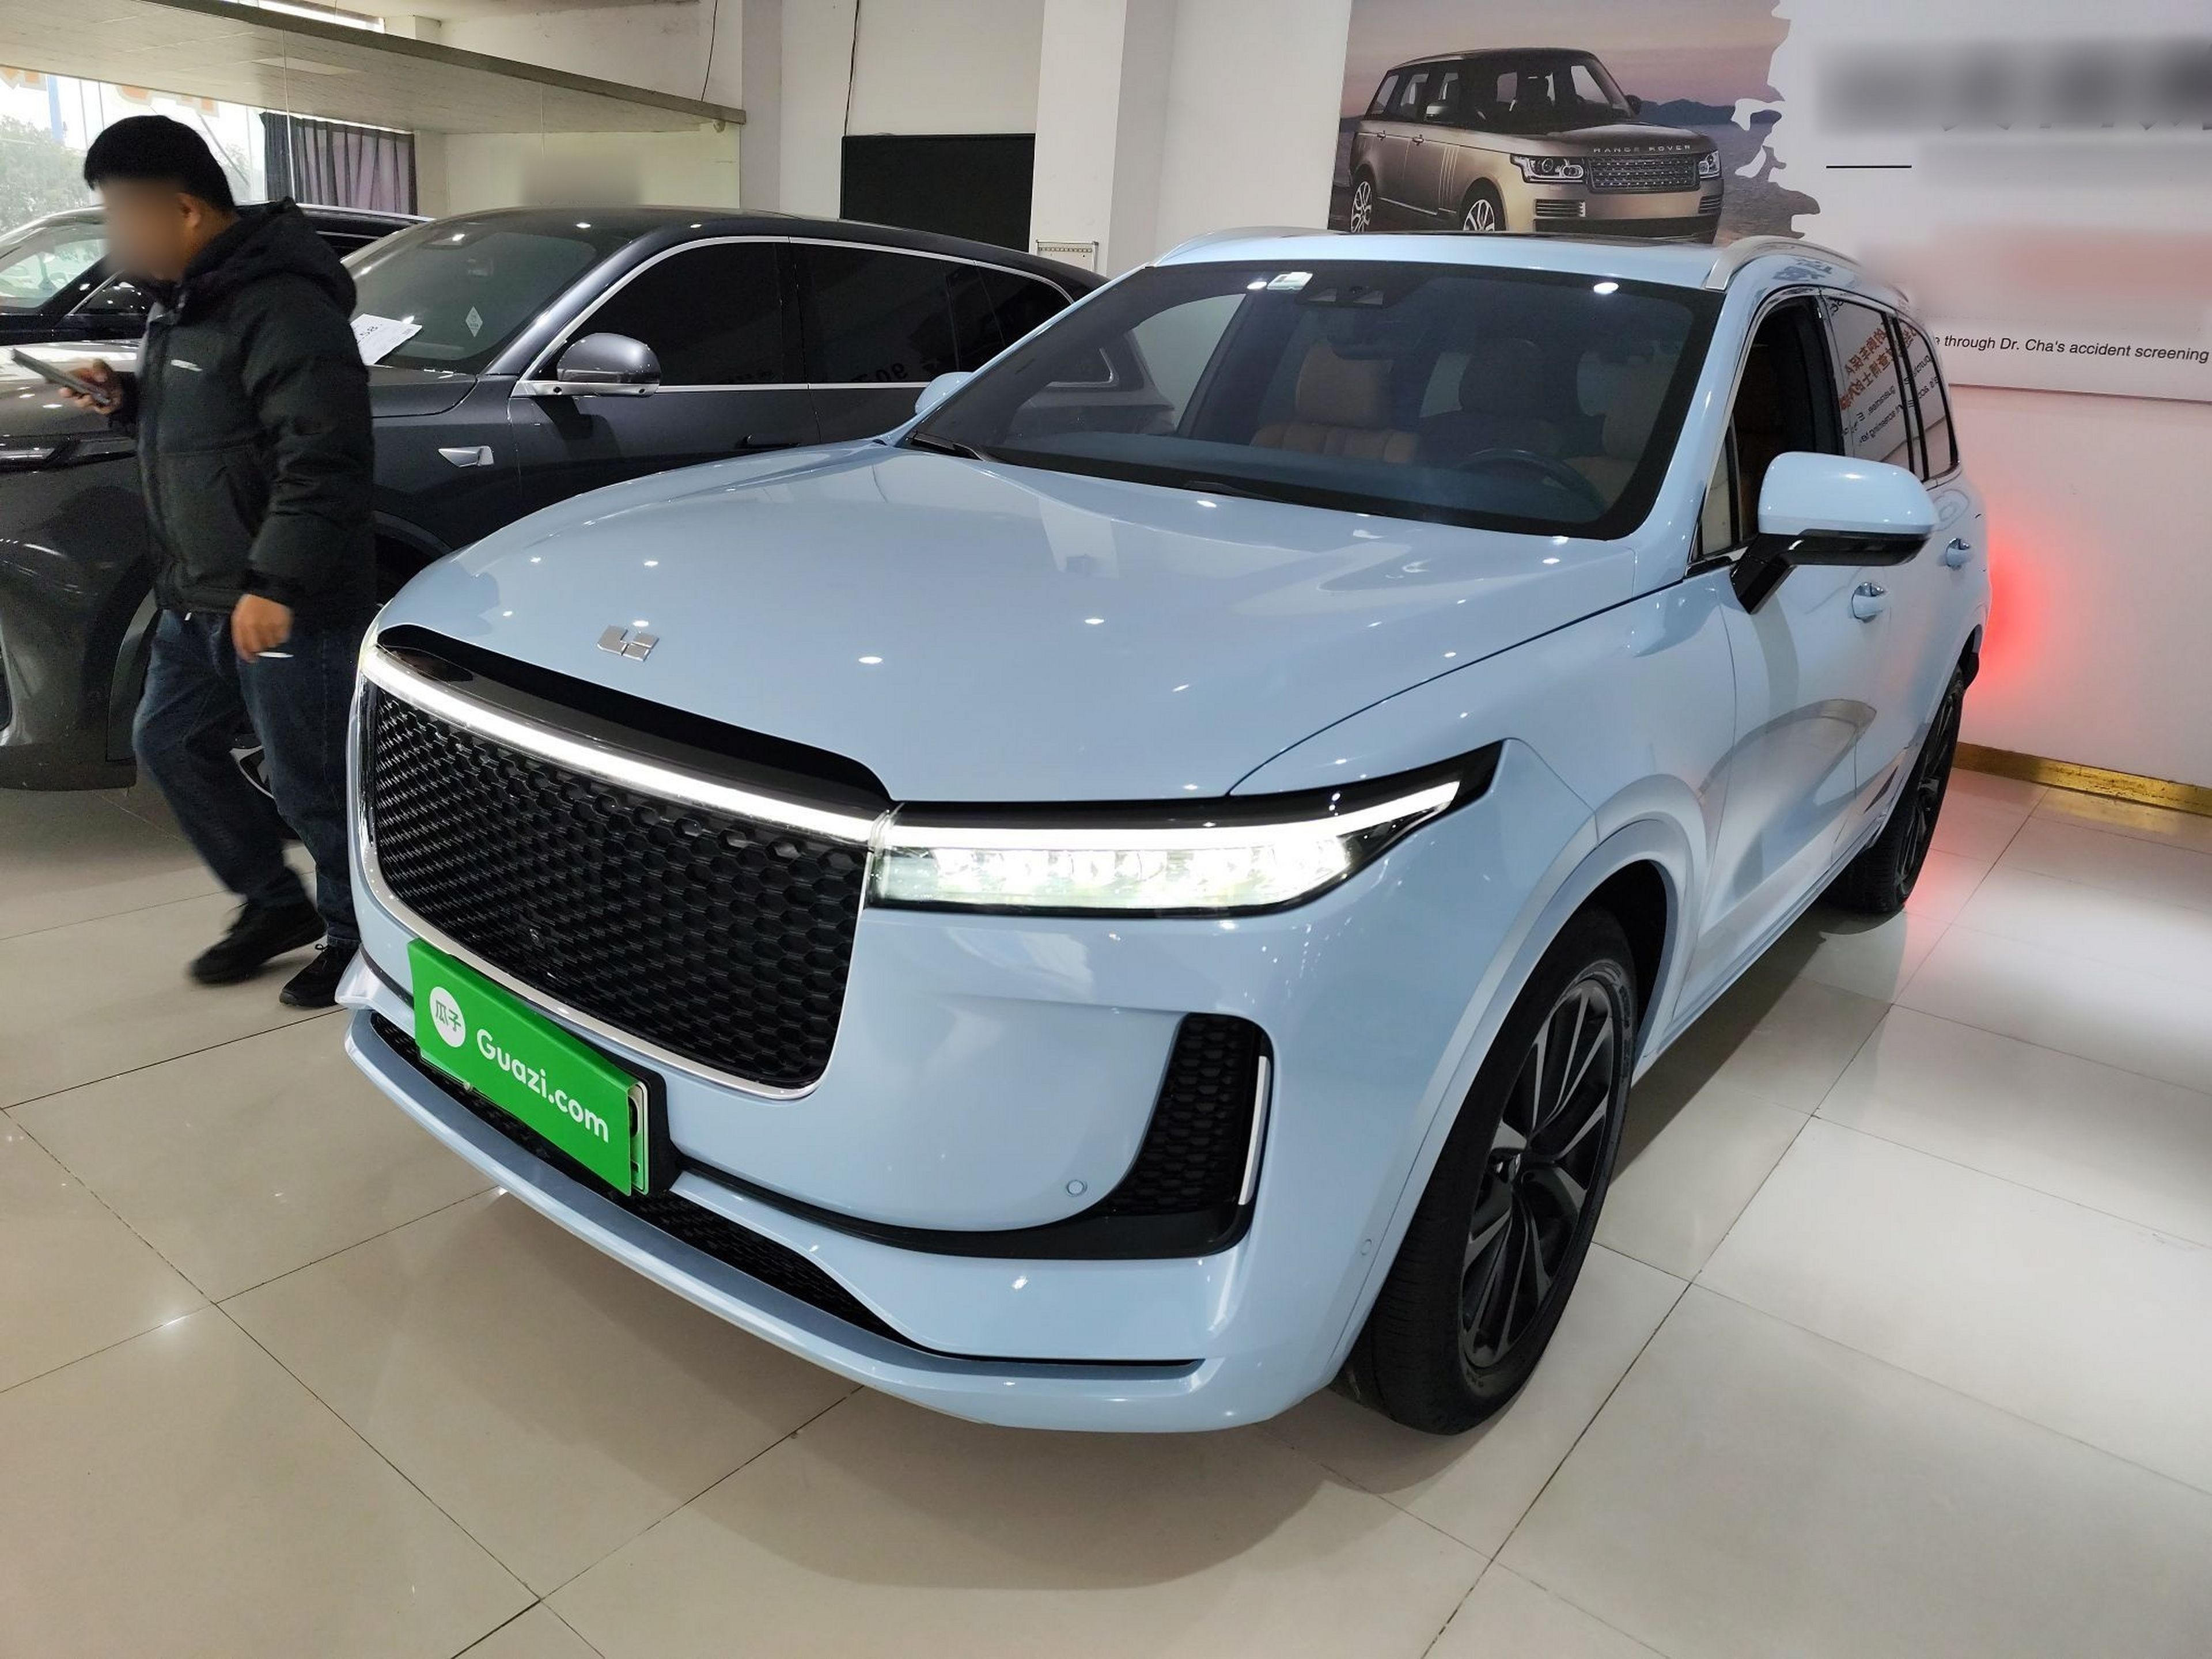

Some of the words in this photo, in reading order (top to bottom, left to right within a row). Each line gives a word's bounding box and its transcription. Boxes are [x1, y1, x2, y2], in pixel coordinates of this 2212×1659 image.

[1945, 335, 1995, 351] through
[2000, 338, 2020, 350] Dr.
[2025, 339, 2065, 352] Cha's
[2070, 344, 2131, 357] accident
[2135, 347, 2209, 363] screening
[435, 999, 461, 1032] 瓜子
[476, 1029, 609, 1143] Guazi.com
